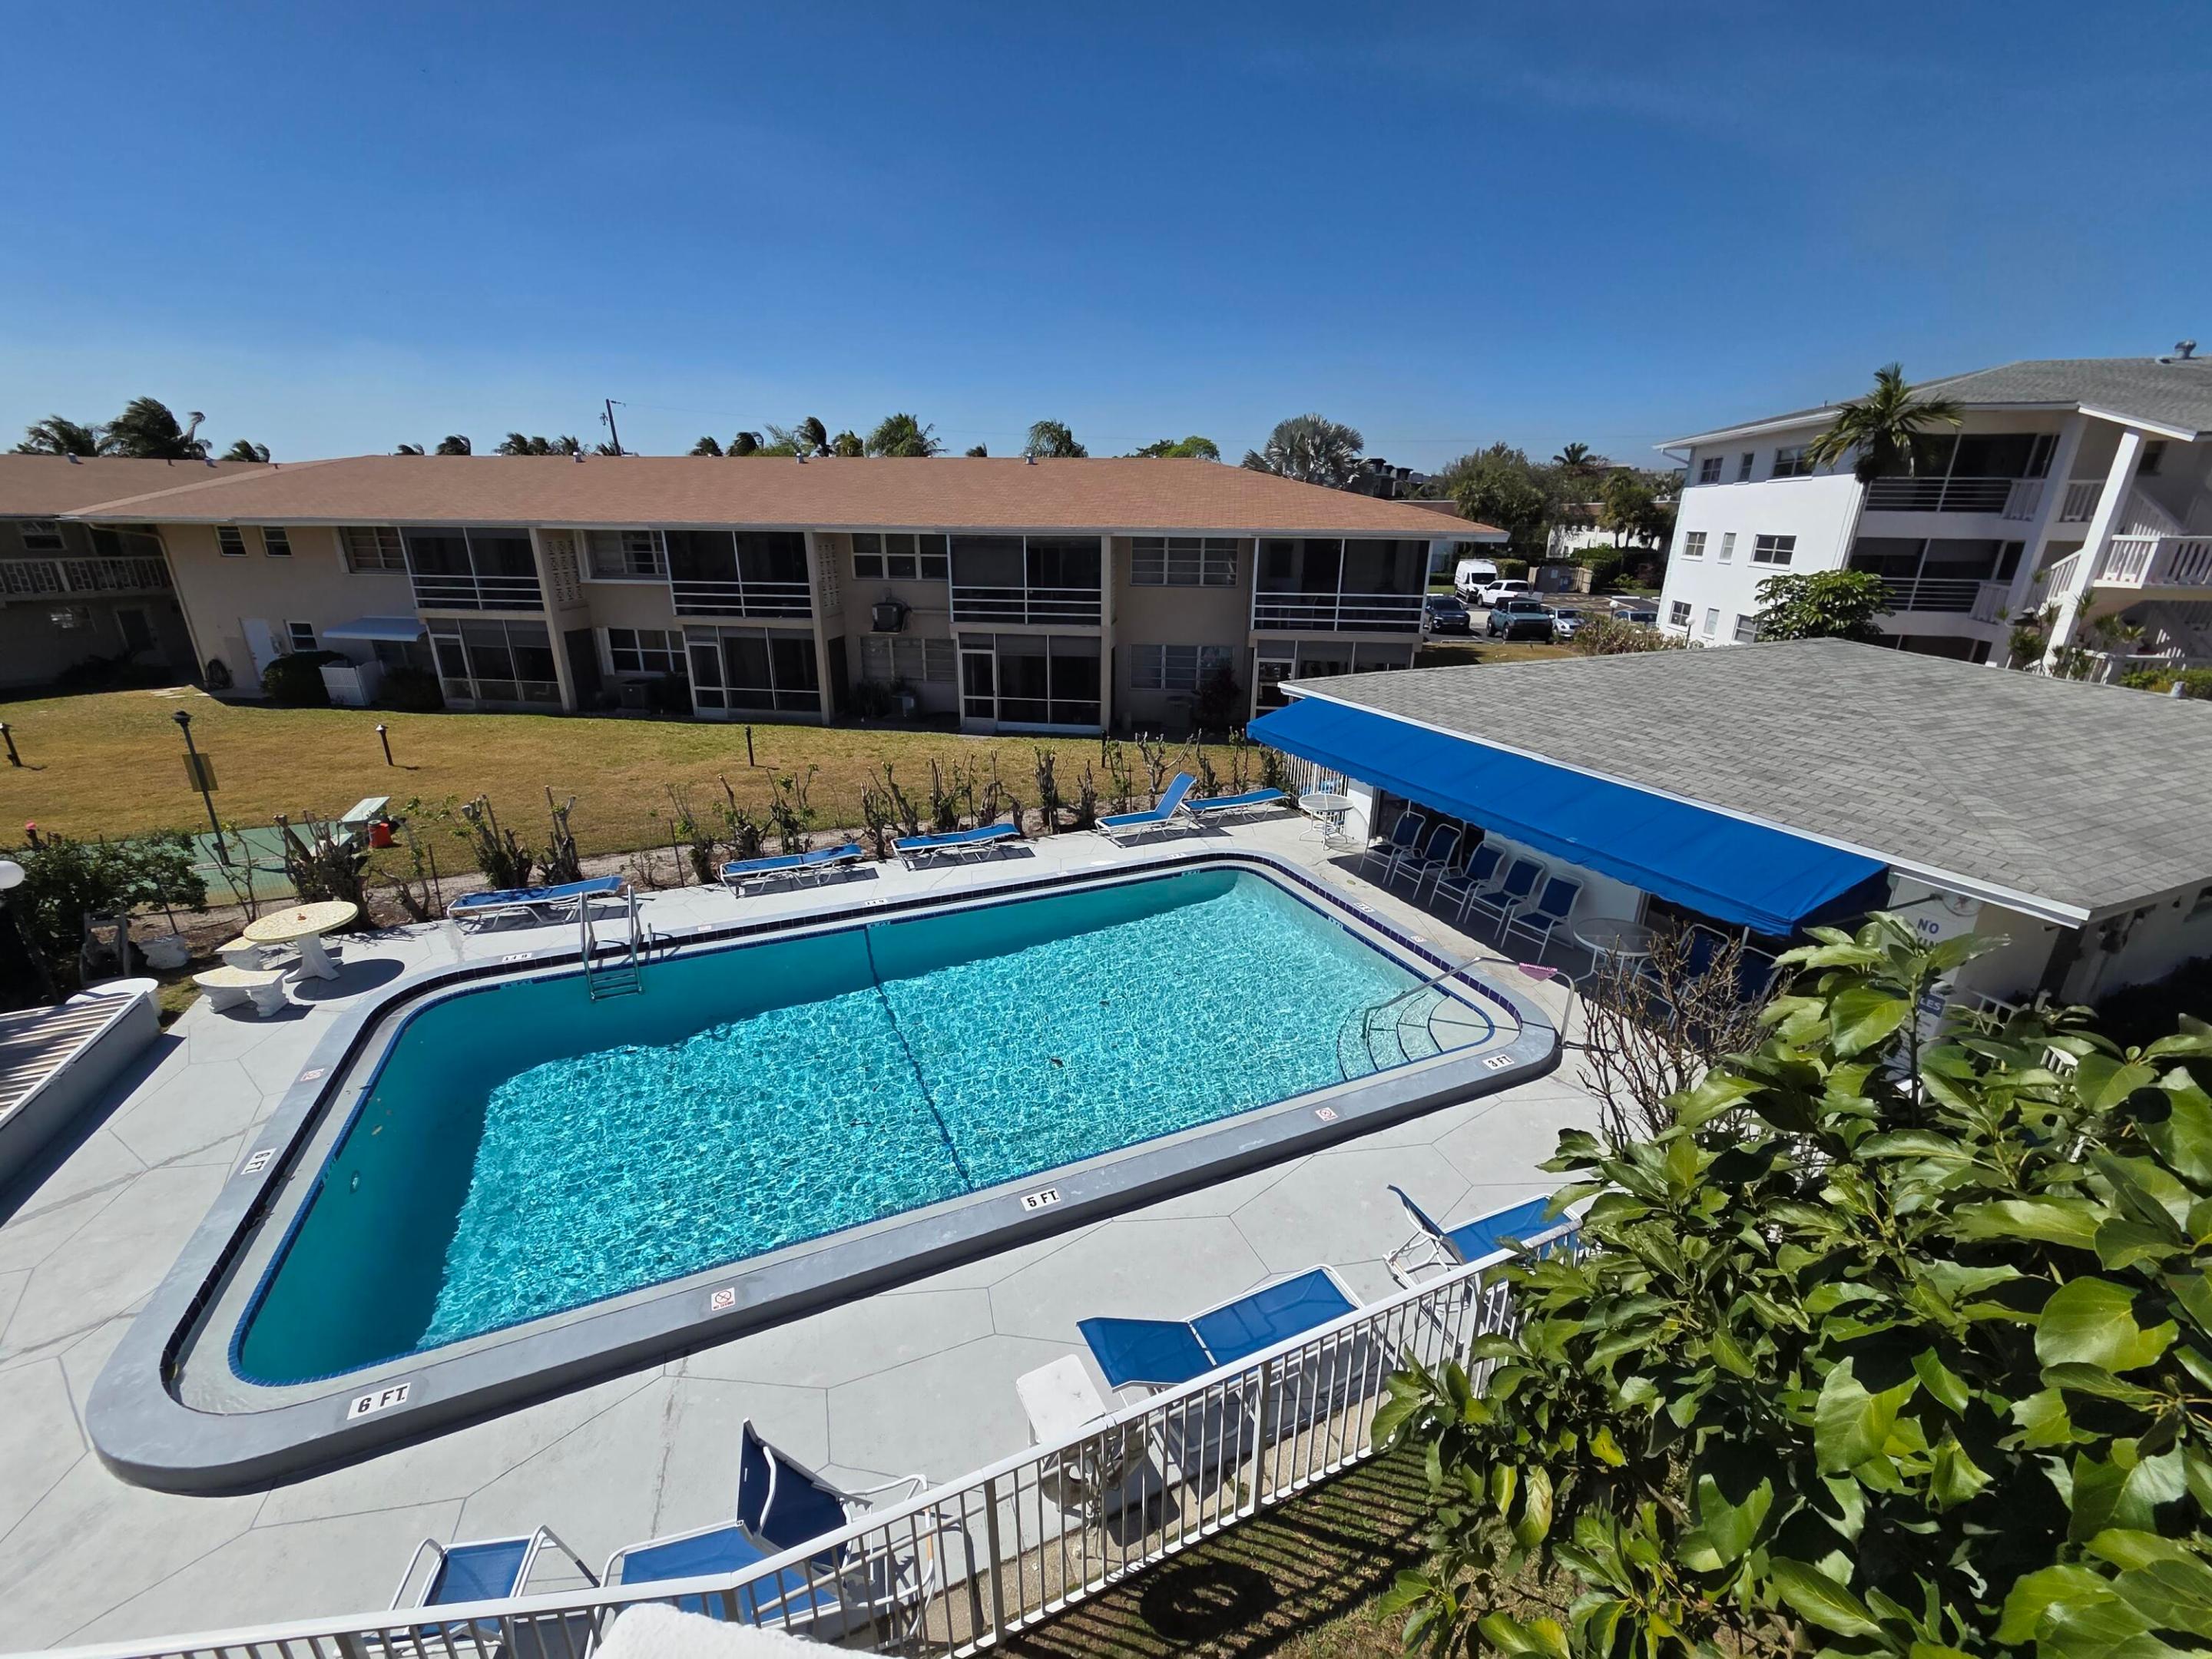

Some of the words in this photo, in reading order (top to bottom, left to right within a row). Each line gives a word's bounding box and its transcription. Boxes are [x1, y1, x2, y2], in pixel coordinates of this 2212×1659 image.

[1917, 918, 1939, 935] NO
[1919, 997, 1942, 1011] LES
[1026, 1196, 1038, 1207] 5
[357, 1397, 373, 1413] 6
